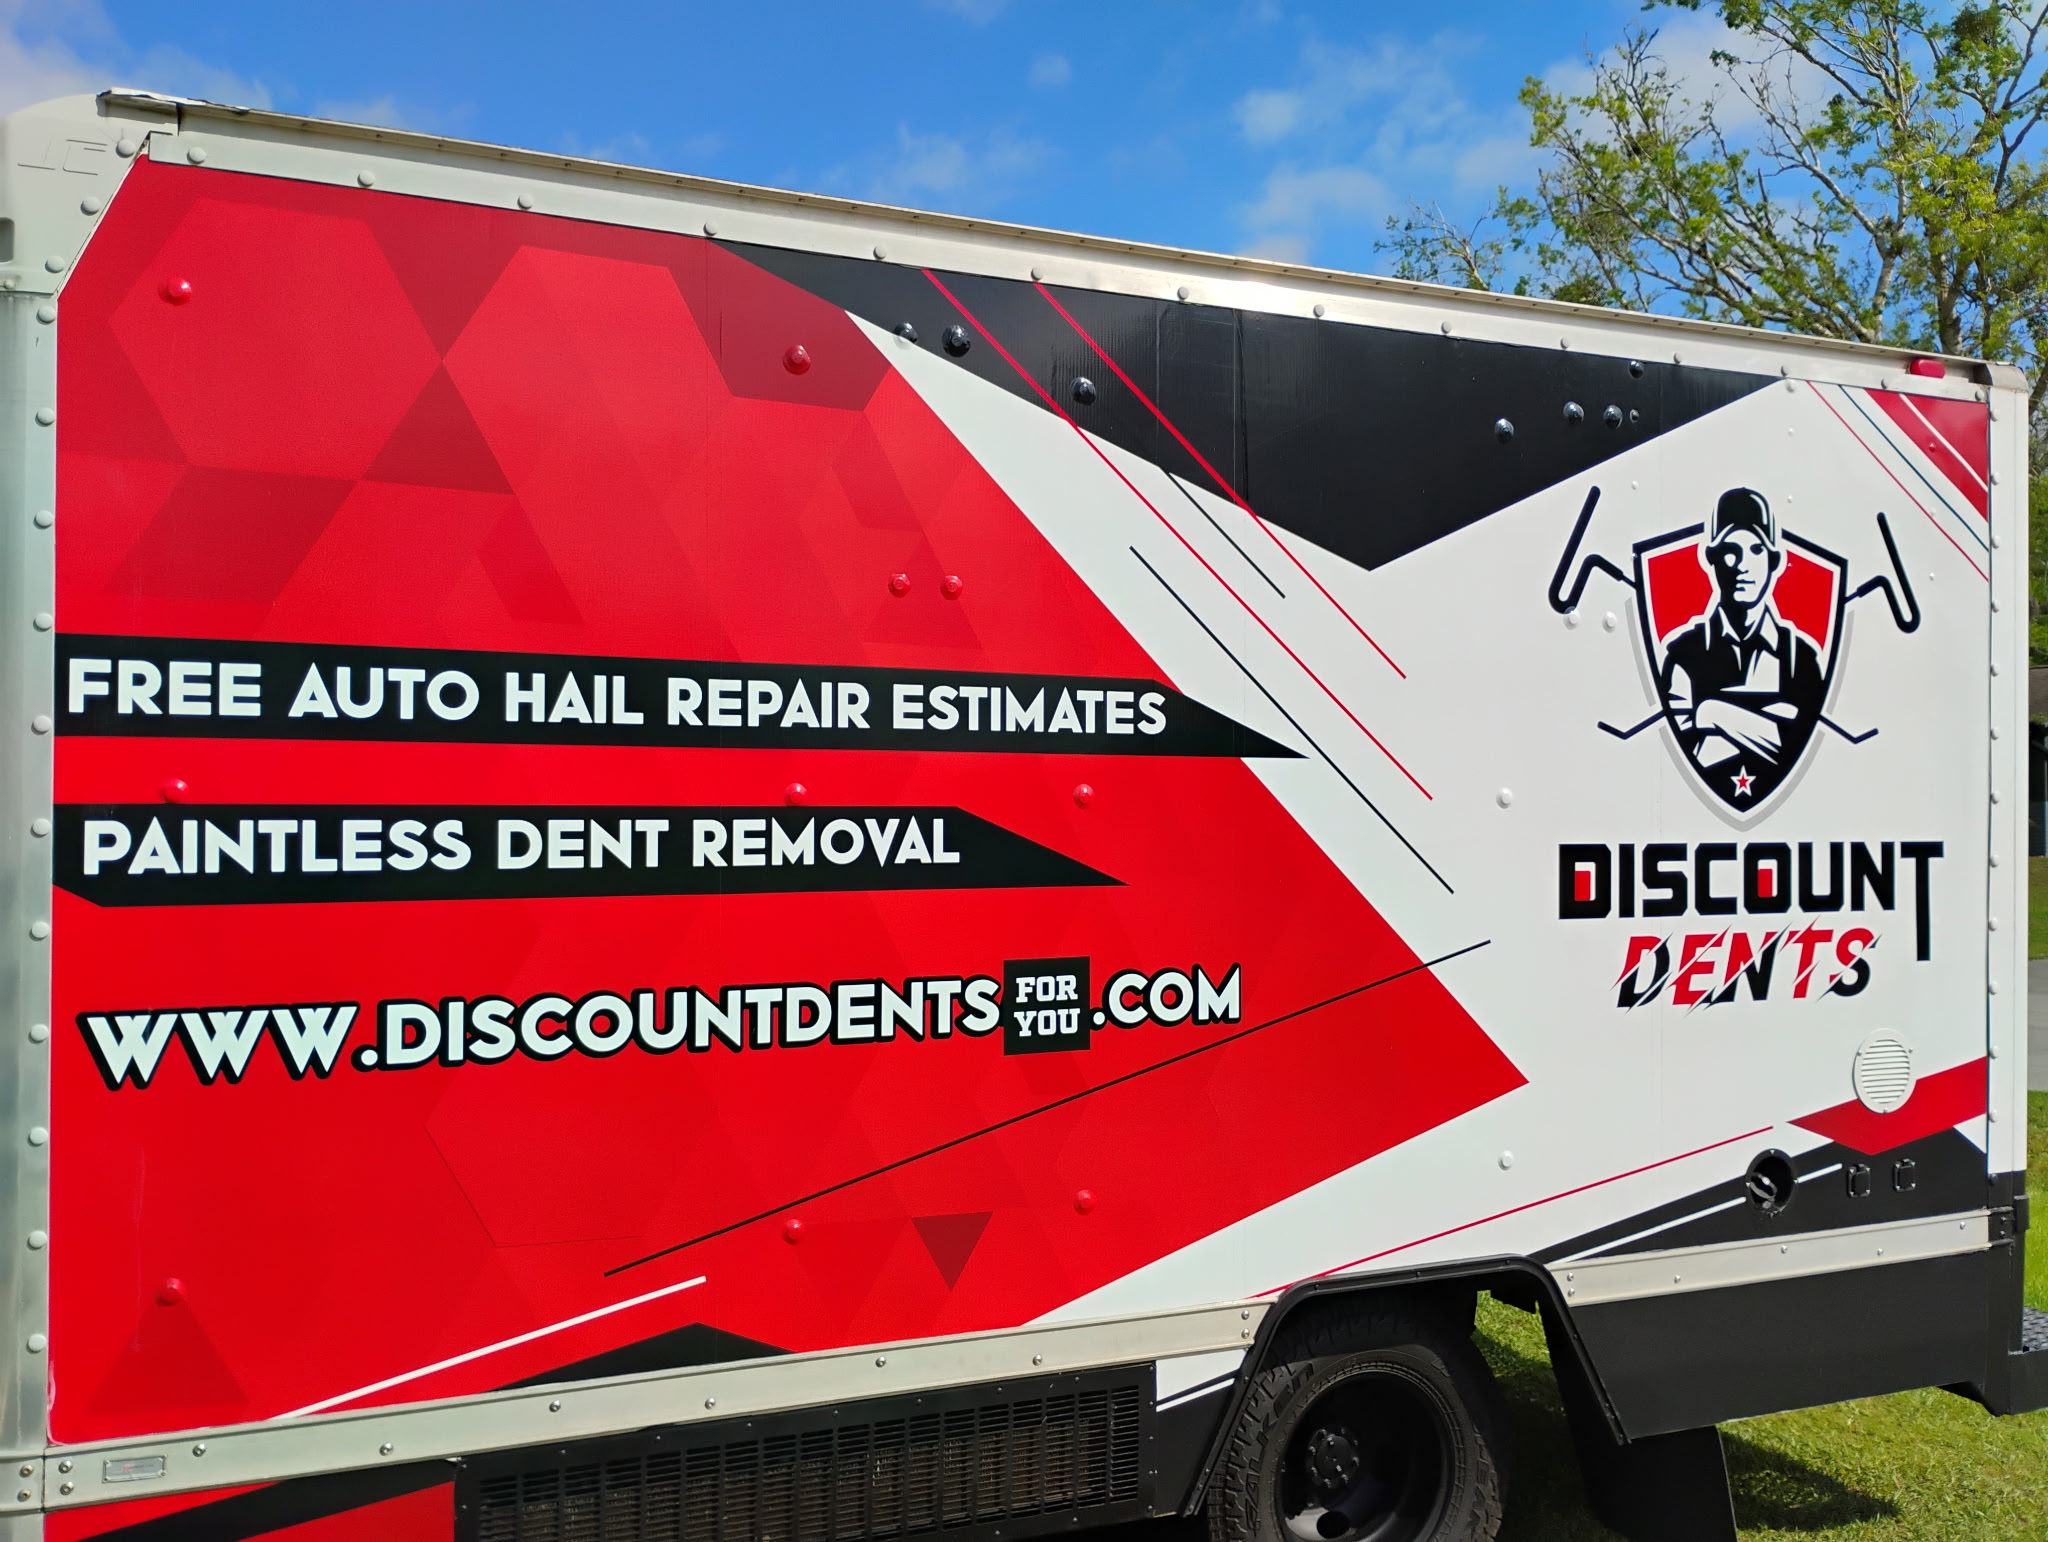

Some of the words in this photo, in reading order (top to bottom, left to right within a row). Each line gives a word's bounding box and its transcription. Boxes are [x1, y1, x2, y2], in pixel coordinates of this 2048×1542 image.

[68, 658, 262, 717] FREE
[287, 662, 480, 721] AUTO
[505, 670, 644, 725] HAIL
[667, 677, 871, 729] REPAIR
[892, 683, 1167, 735] ESTIMATES
[83, 816, 472, 875] PAINTLESS
[497, 819, 670, 870] DENT
[692, 815, 960, 867] REMOVAL
[1558, 841, 1944, 962] DISCOUNT
[1015, 974, 1079, 1003] FOR
[1612, 917, 1881, 1016] DENTS
[1013, 1007, 1081, 1037] YOU
